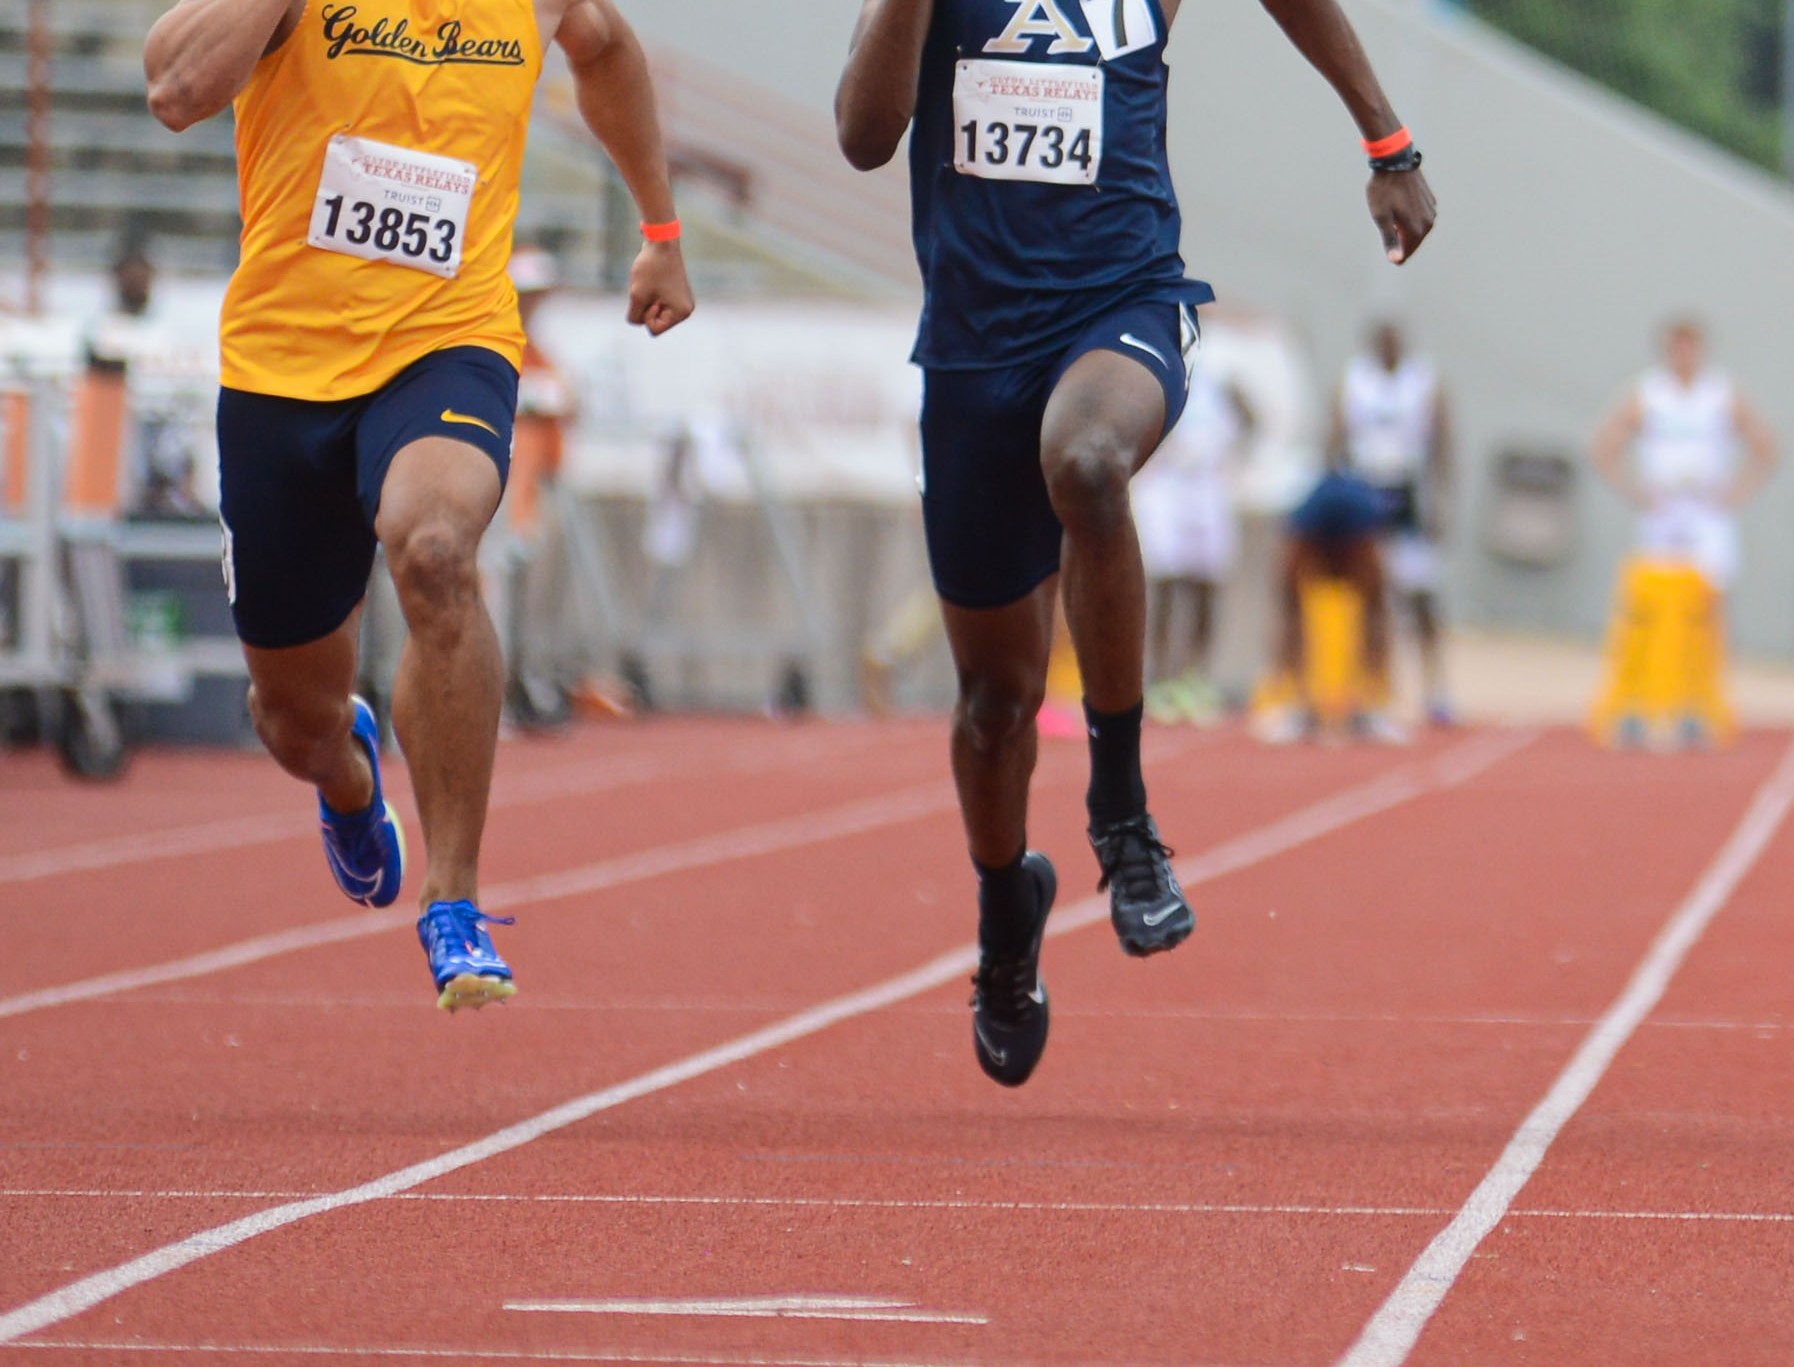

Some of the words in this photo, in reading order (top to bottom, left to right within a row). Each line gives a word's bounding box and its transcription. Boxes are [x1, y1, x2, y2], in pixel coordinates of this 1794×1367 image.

[321, 3, 428, 60] Golden
[432, 20, 523, 59] Bears
[990, 83, 1040, 98] TEXAS
[1043, 87, 1099, 101] RELAYS
[1014, 107, 1055, 119] TRUIST
[959, 119, 1093, 171] 13734
[362, 162, 412, 183] TEXAS
[414, 174, 470, 195] RELAYS
[384, 190, 425, 206] TRUIST
[324, 194, 457, 264] 13853
